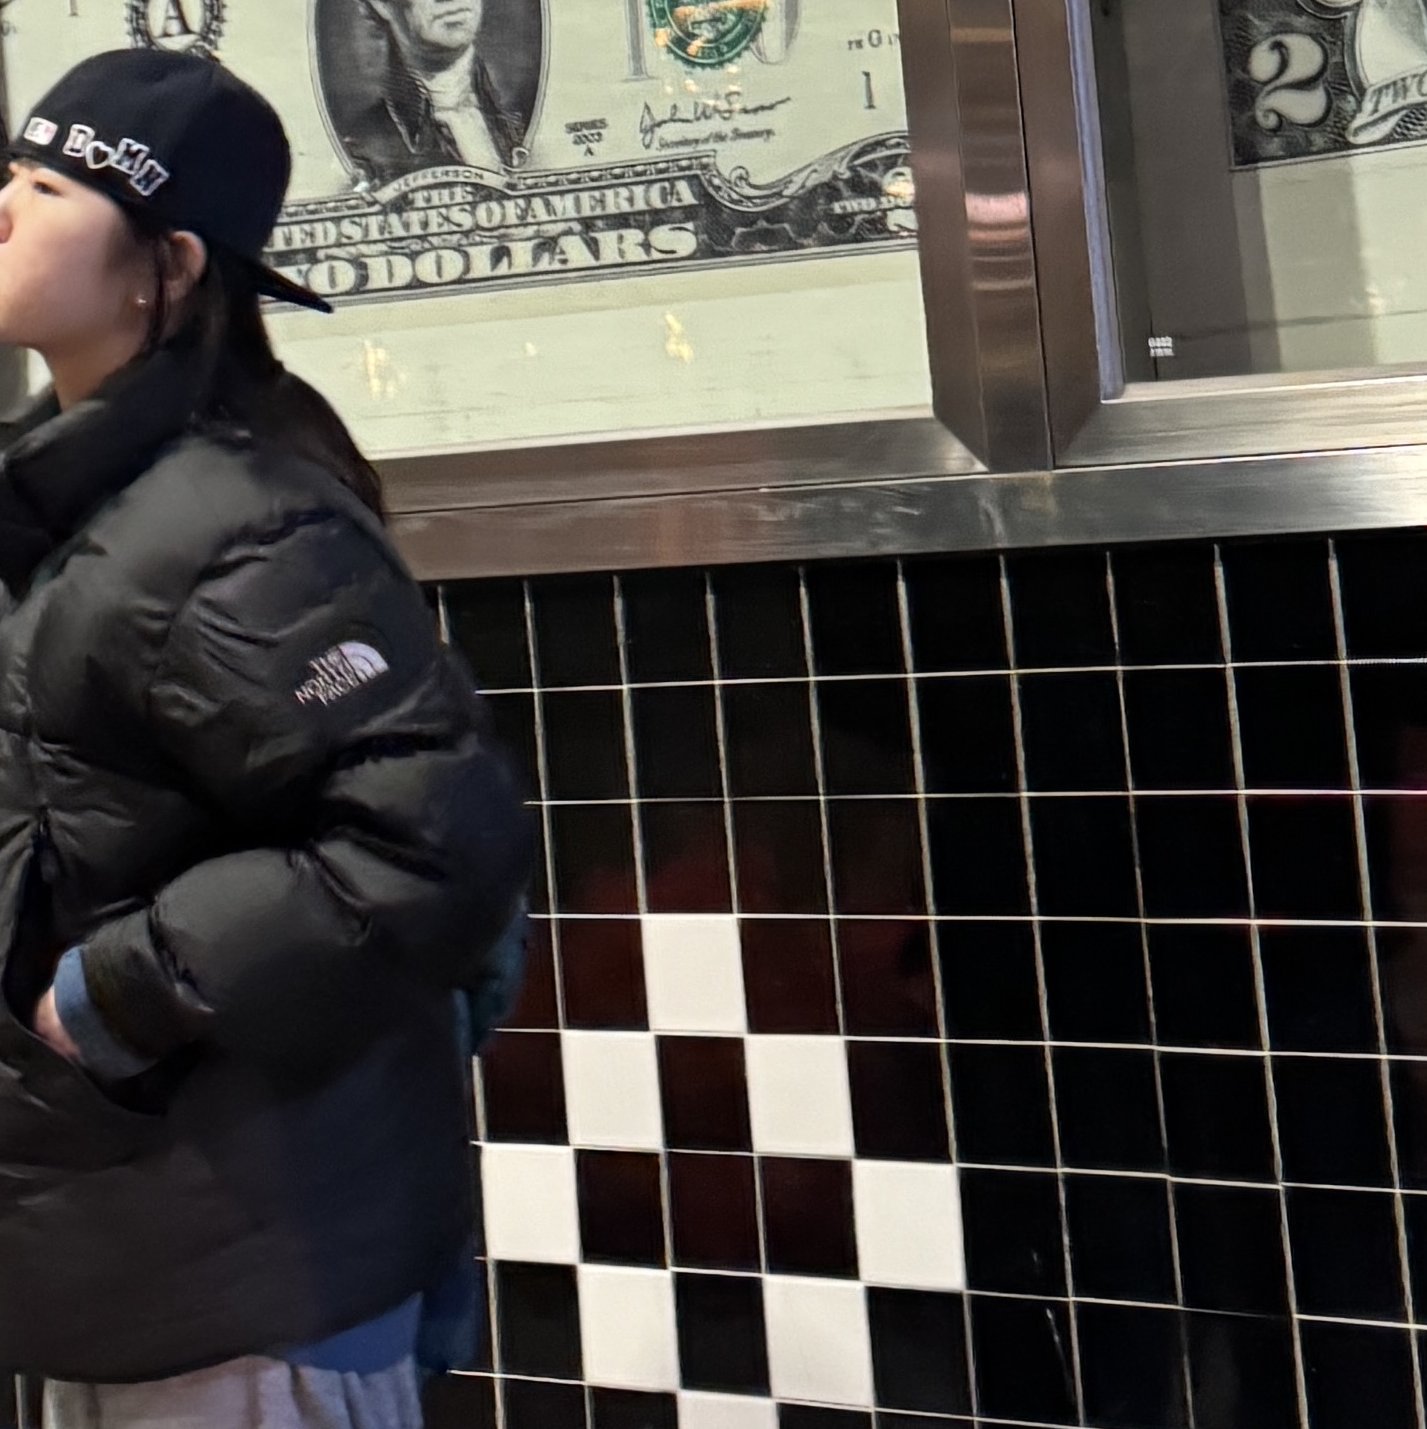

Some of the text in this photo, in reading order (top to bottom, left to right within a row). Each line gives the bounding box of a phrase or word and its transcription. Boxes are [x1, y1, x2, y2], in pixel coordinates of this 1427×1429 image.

[1248, 32, 1332, 133] 2
[338, 205, 473, 246] STATES
[522, 178, 700, 223] AMERICA
[411, 184, 474, 210] THE
[363, 222, 700, 288] DOLLARS
